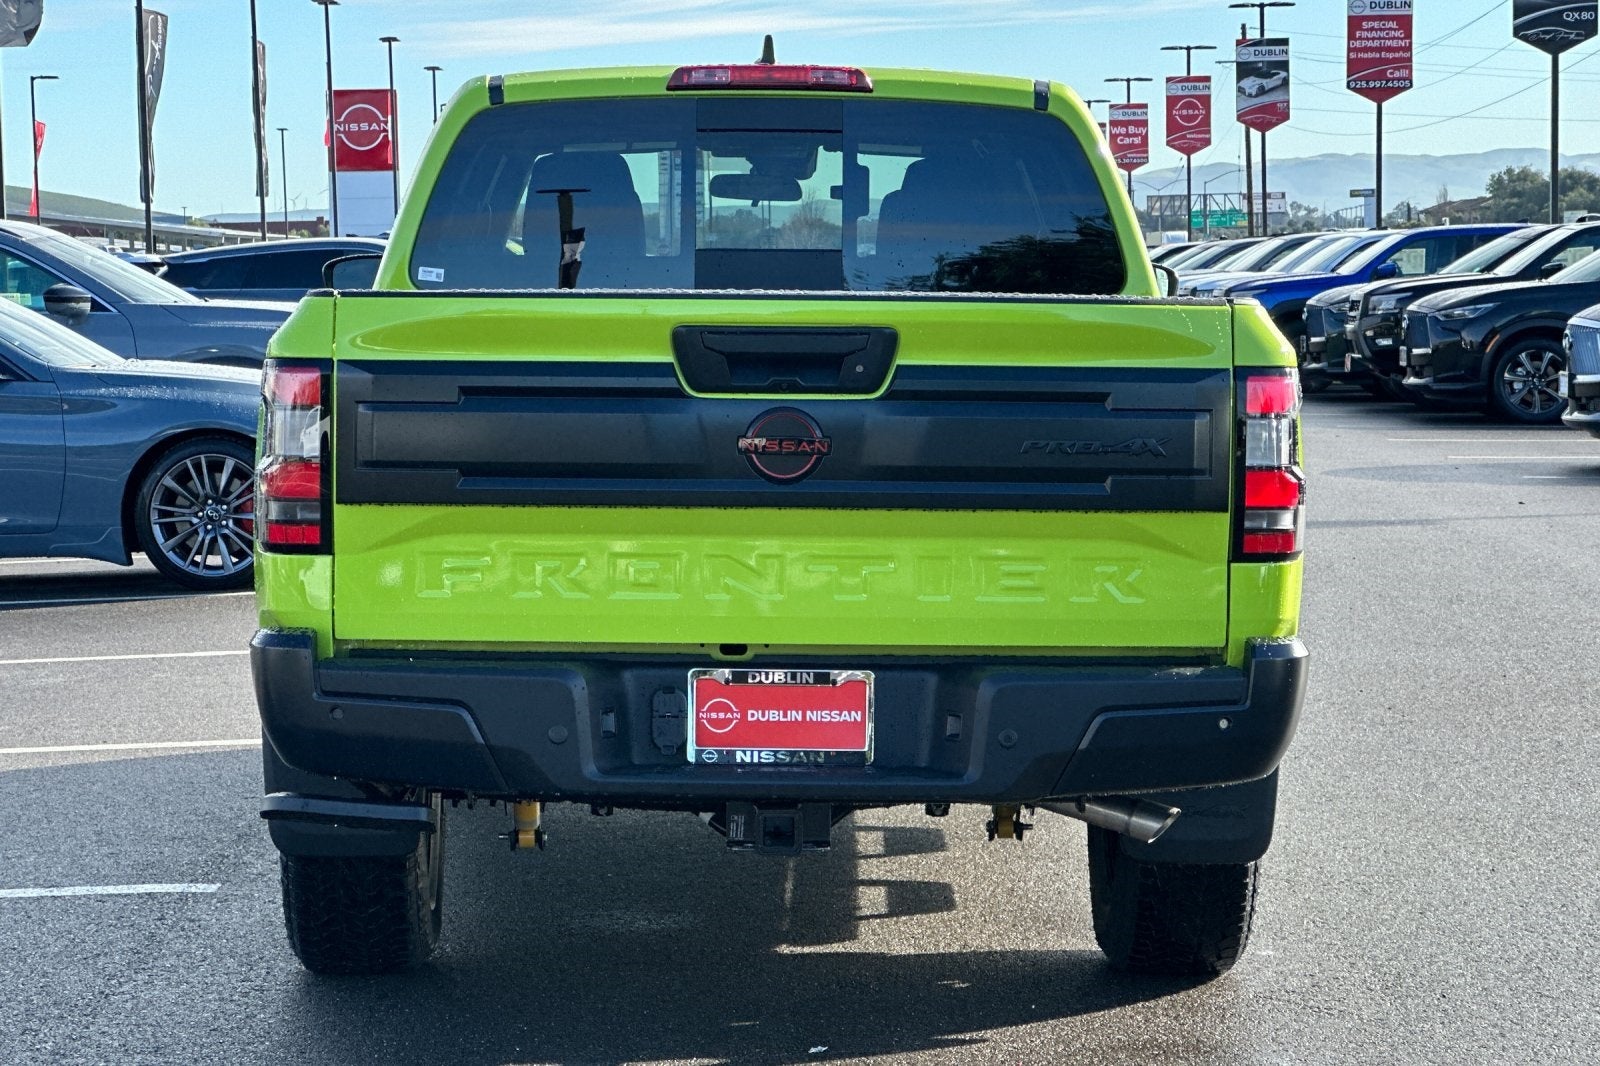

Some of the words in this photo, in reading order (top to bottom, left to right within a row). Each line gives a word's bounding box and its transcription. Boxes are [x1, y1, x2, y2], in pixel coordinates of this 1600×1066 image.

[1369, 0, 1411, 9] DUBLIN
[1563, 11, 1595, 21] QX80
[1362, 21, 1399, 29] SPECIAL
[1356, 30, 1404, 38] FINANCING
[1350, 39, 1410, 48] DEPARTMENT
[1253, 49, 1288, 57] DUBLIN
[1381, 51, 1410, 59] Español
[1387, 69, 1409, 78] Call!
[1349, 80, 1410, 88] 925.997.4505
[335, 123, 388, 131] NISSAN
[1110, 126, 1127, 134] We
[1128, 125, 1147, 136] Buy
[1117, 136, 1142, 144] Cars!
[740, 439, 828, 452] NISSAN
[415, 550, 1147, 603] FRONTIER
[747, 671, 814, 684] DUBLIN
[747, 710, 802, 722] DUBLIN
[806, 710, 862, 722] NISSAN
[735, 750, 825, 763] NISSAN
